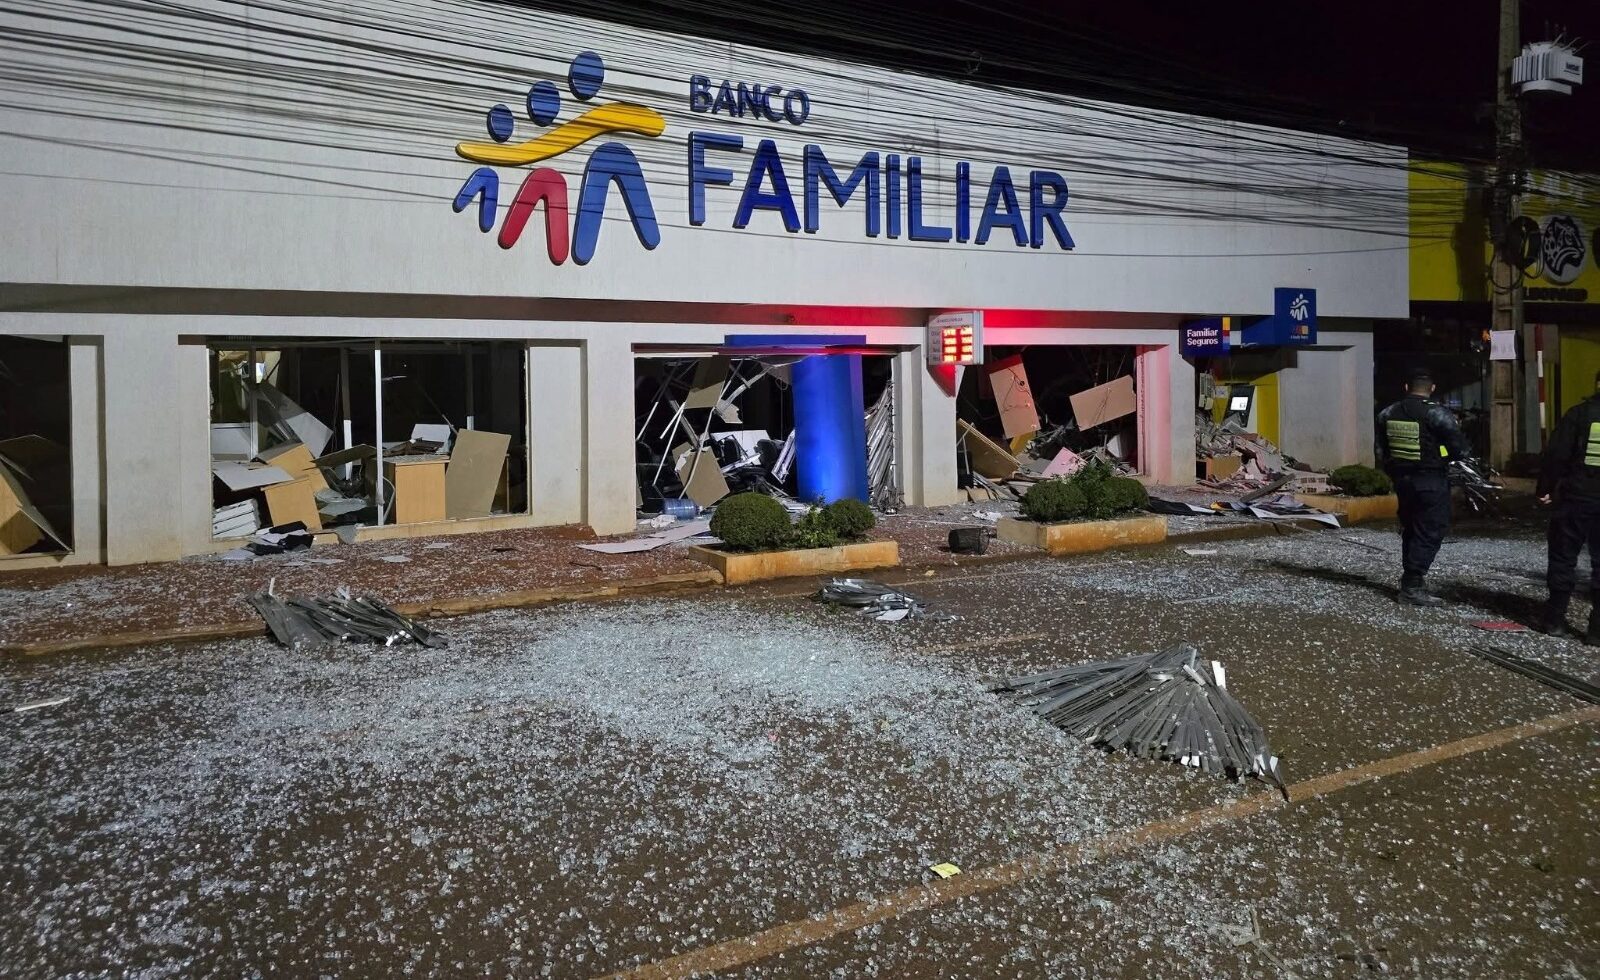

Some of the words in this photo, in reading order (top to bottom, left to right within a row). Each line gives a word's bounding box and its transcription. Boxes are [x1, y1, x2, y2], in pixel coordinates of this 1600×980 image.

[689, 73, 810, 125] BANCO
[688, 131, 1075, 250] FAMILIAR
[1186, 328, 1219, 337] Familiar
[1186, 337, 1219, 347] Seguros
